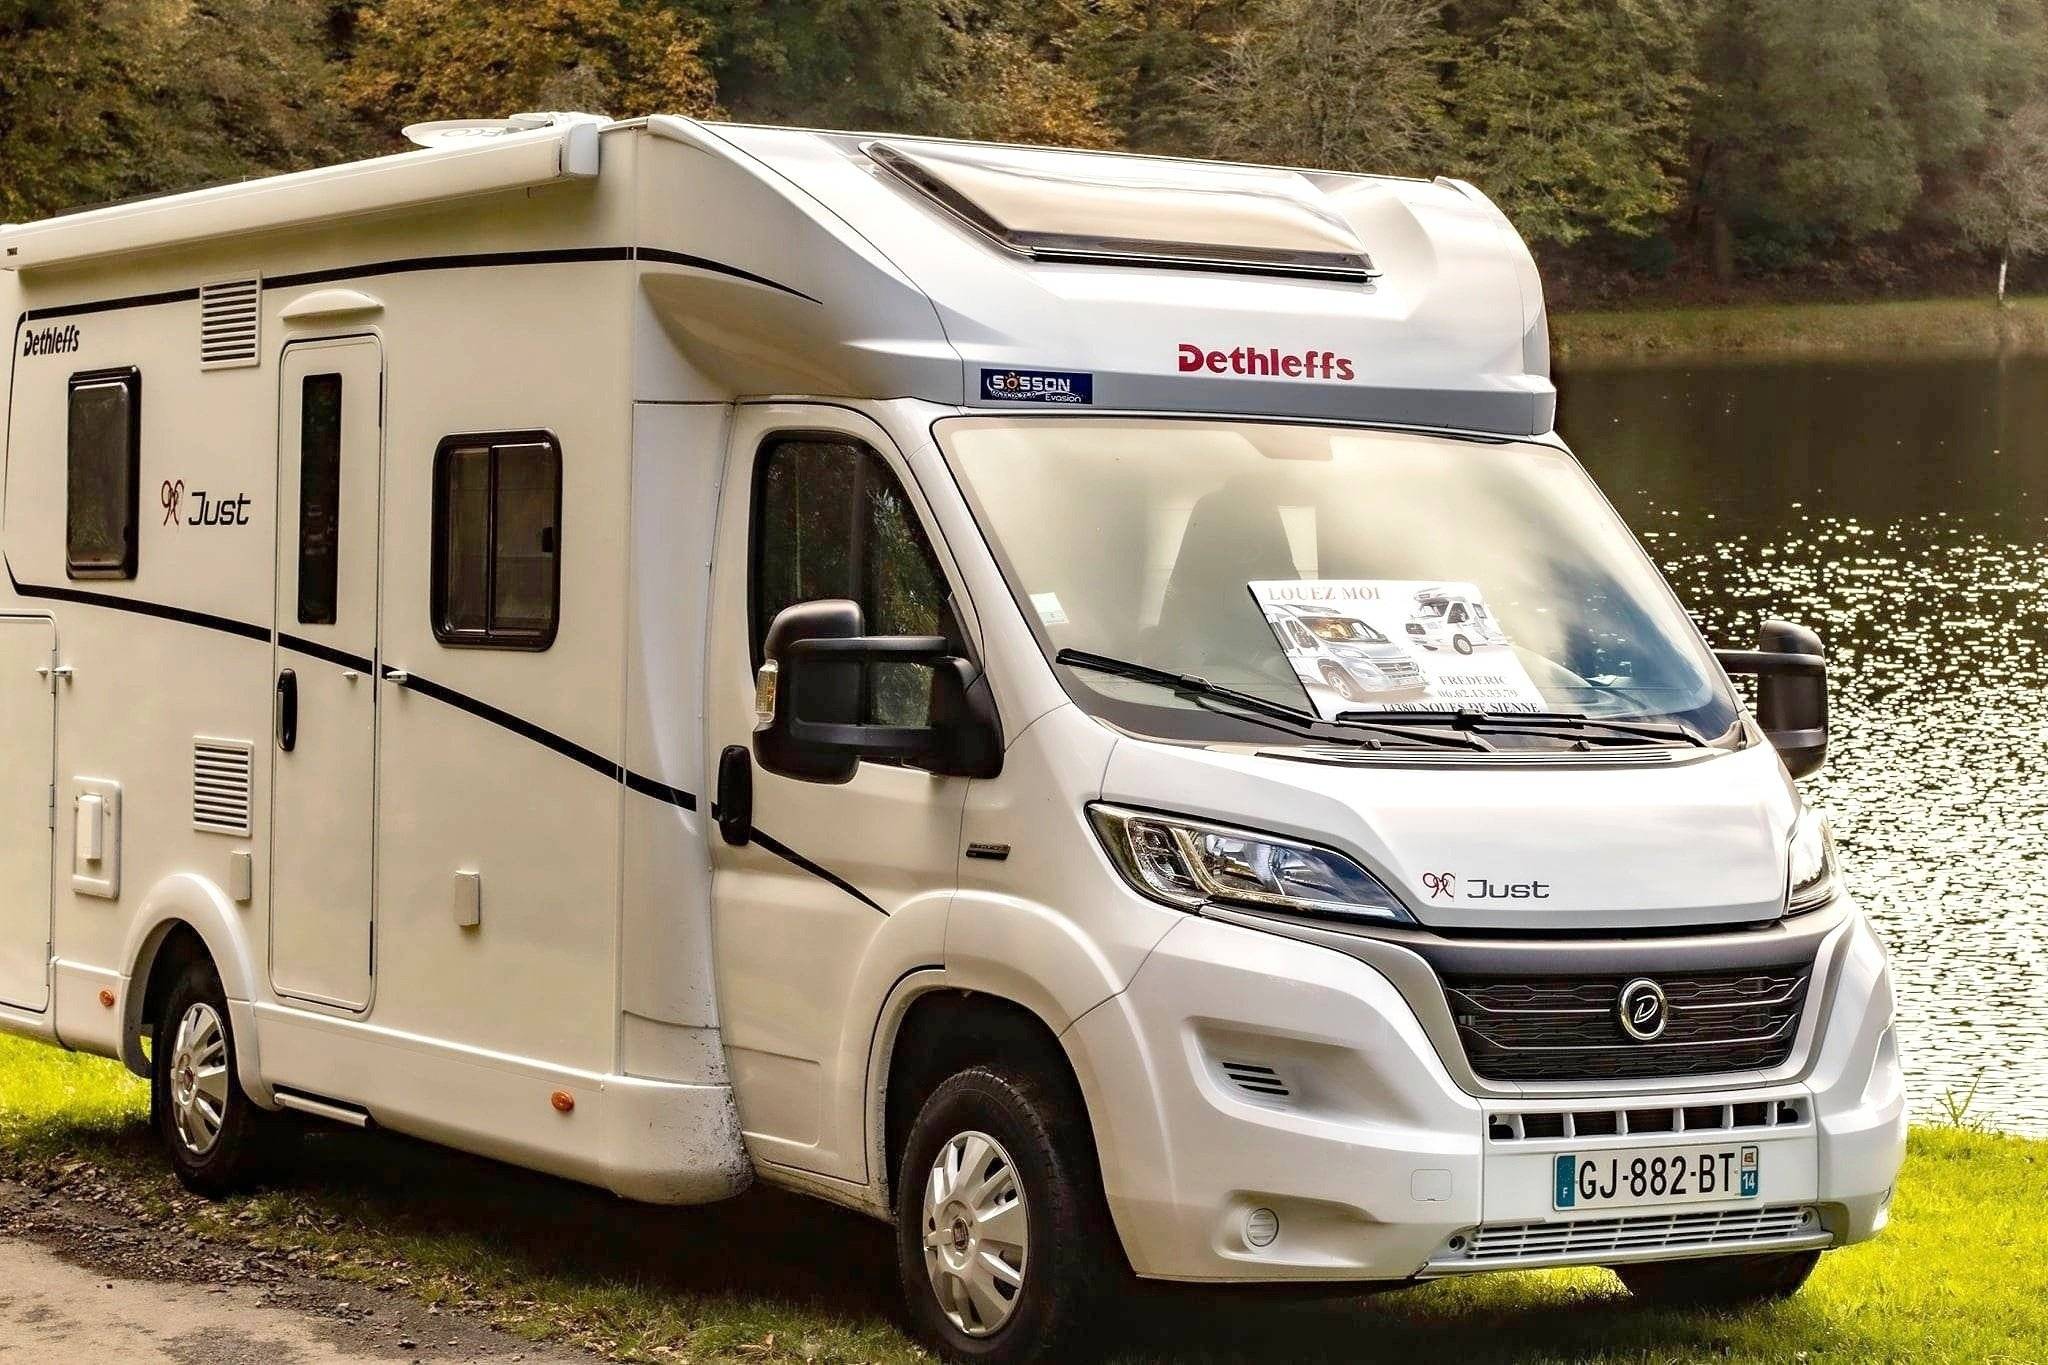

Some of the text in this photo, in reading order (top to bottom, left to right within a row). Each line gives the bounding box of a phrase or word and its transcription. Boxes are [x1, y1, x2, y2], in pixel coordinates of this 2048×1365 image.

[24, 325, 80, 357] Dethleffs
[1178, 343, 1355, 381] Dethleffs
[1045, 393, 1082, 403] Evasion
[188, 492, 251, 525] Just
[1267, 586, 1381, 600] LOUEZ MOI
[1467, 879, 1550, 899] Just
[1562, 1152, 1755, 1200] F GJ-882-BT 14
